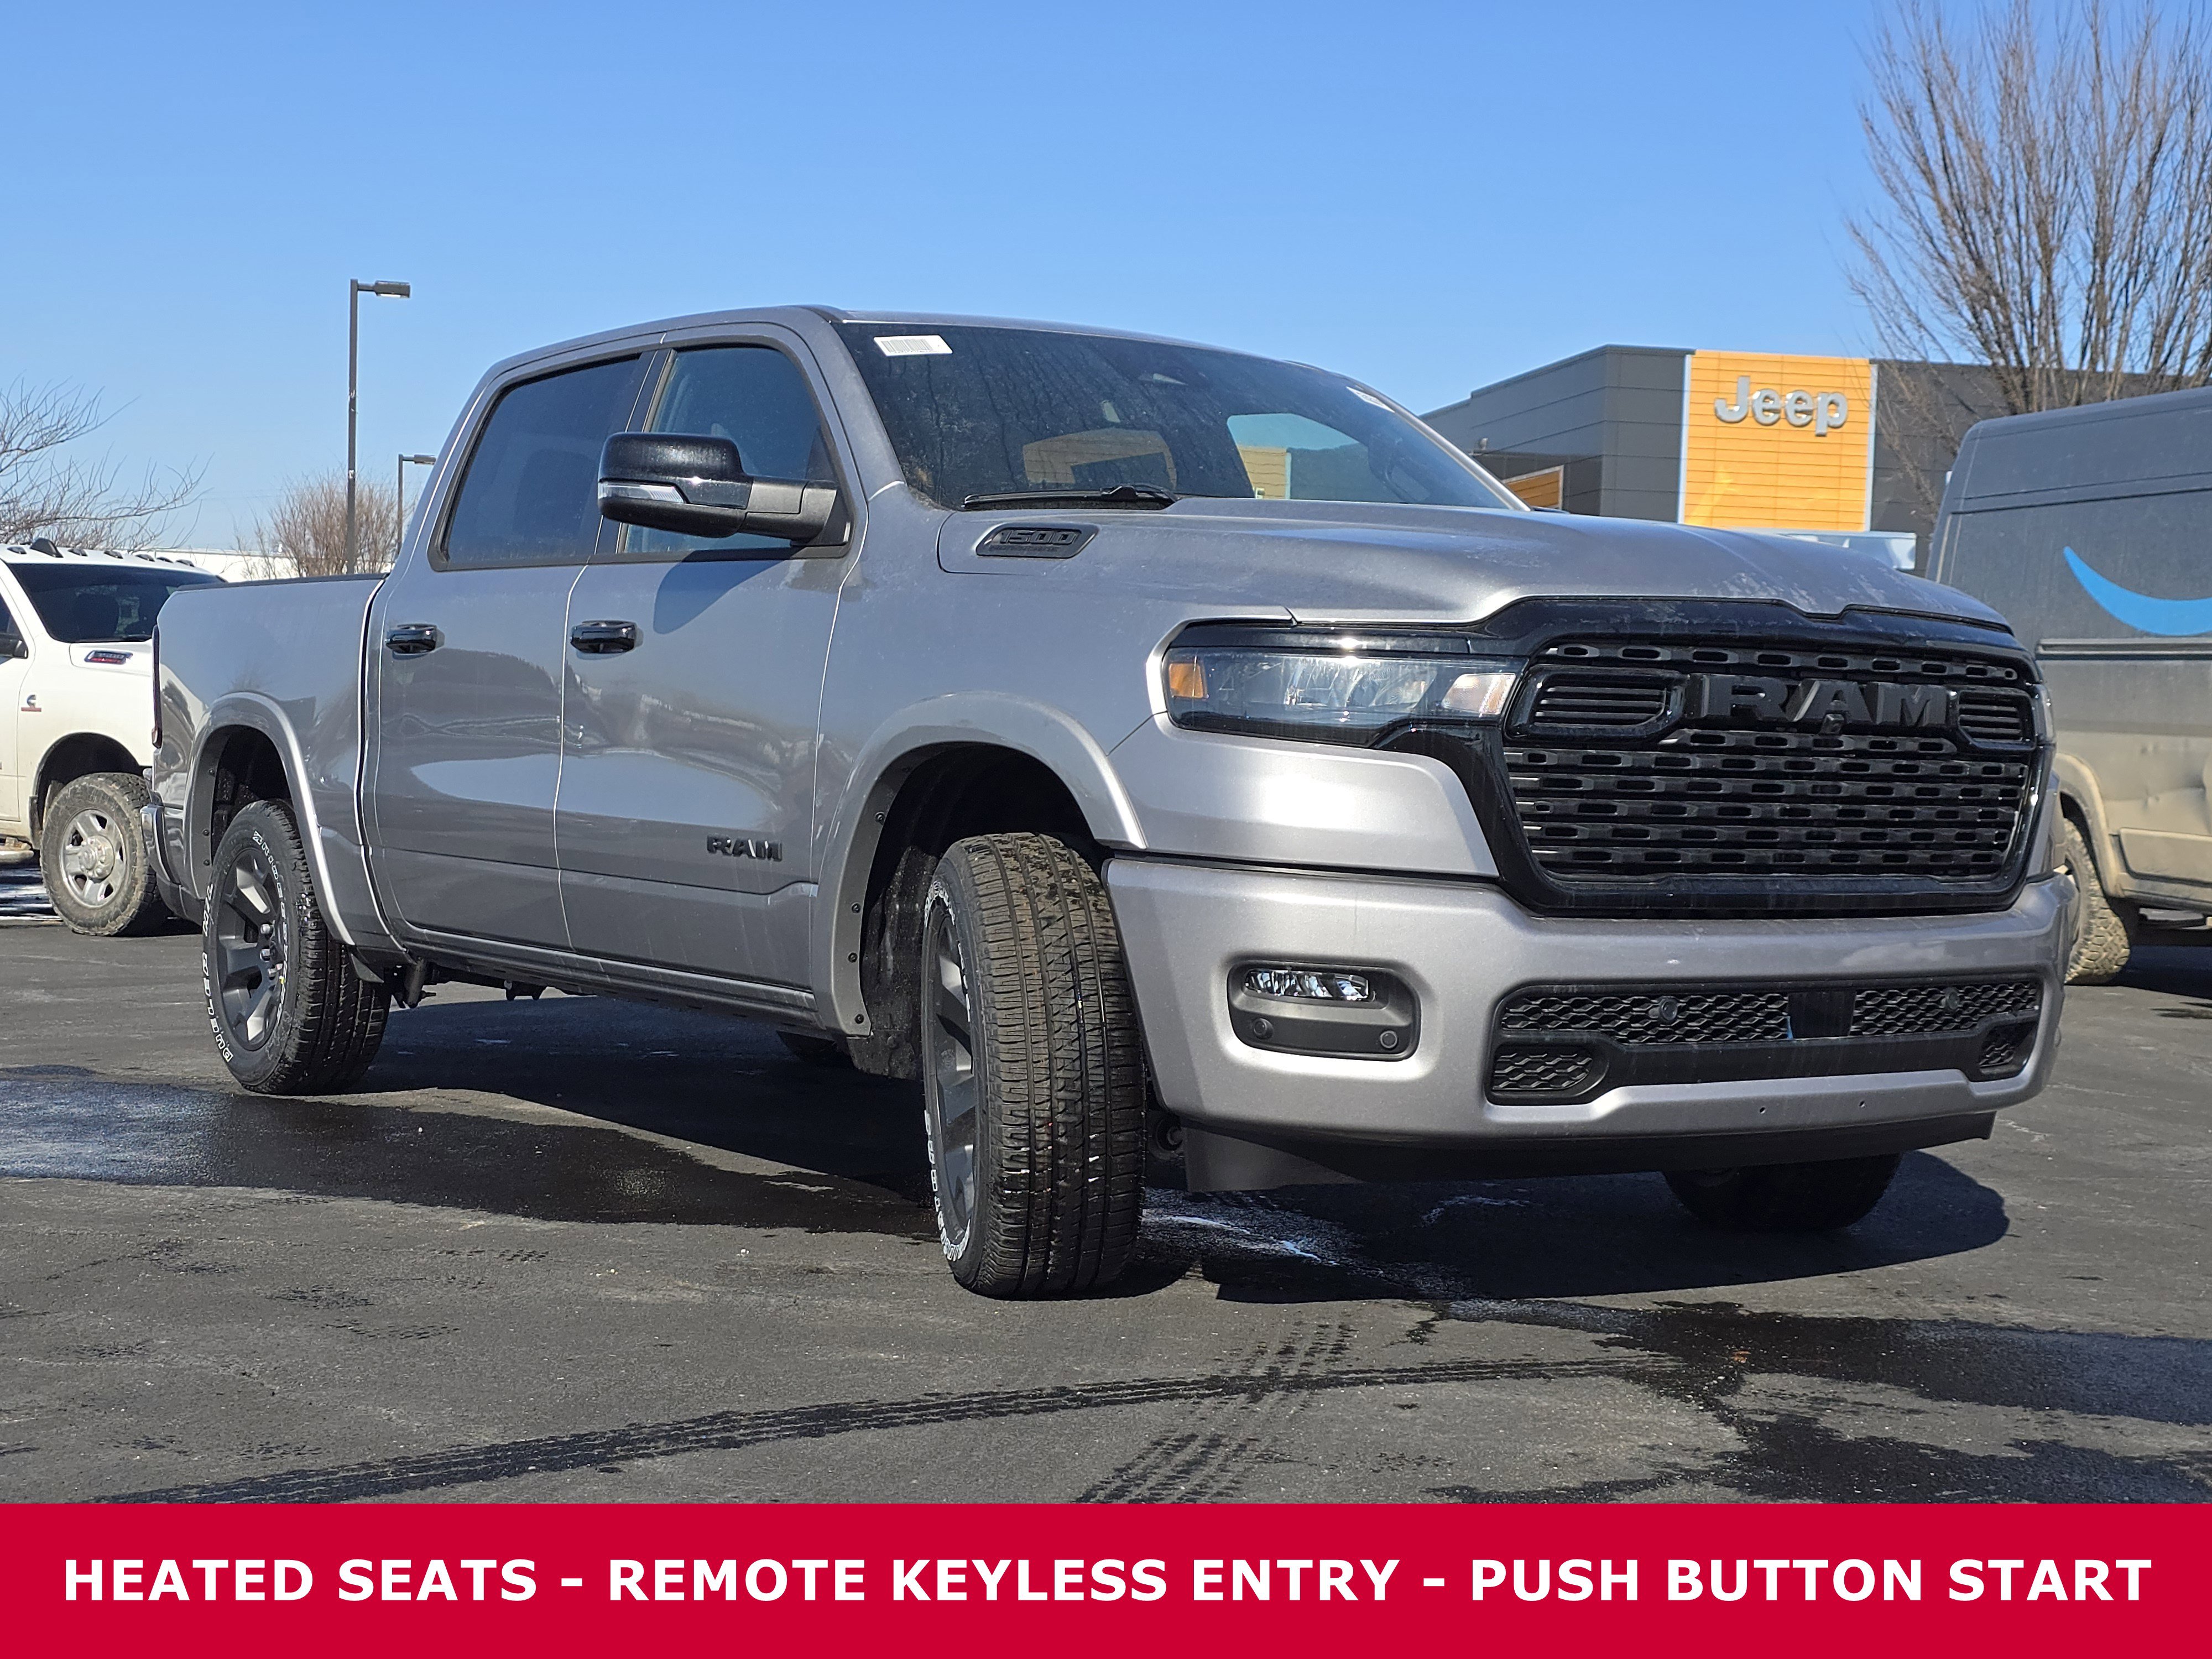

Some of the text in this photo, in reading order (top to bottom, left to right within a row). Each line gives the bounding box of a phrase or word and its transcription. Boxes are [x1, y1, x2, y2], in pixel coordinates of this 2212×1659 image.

[1714, 376, 1848, 437] Jeep
[993, 529, 1078, 545] 1500
[1697, 673, 1947, 729] RAM
[707, 834, 782, 862] RAM
